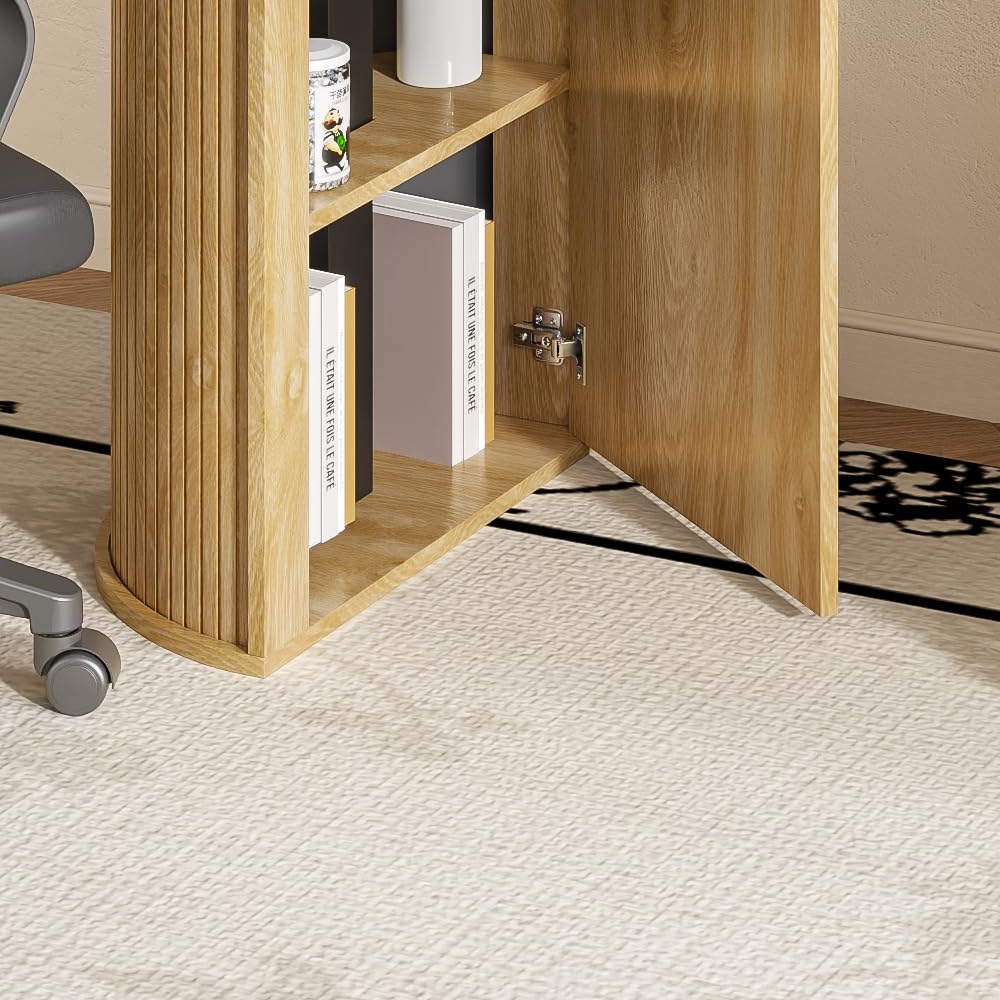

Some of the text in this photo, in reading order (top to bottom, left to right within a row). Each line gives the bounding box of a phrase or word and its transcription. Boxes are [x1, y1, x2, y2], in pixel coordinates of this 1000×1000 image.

[468, 276, 476, 288] IL
[468, 321, 476, 344] UNE
[326, 346, 335, 359] IL
[468, 344, 476, 369] FOIS
[468, 370, 476, 384] LE
[326, 393, 335, 418] UNE
[326, 418, 335, 444] FOIS
[326, 445, 335, 460] LE
